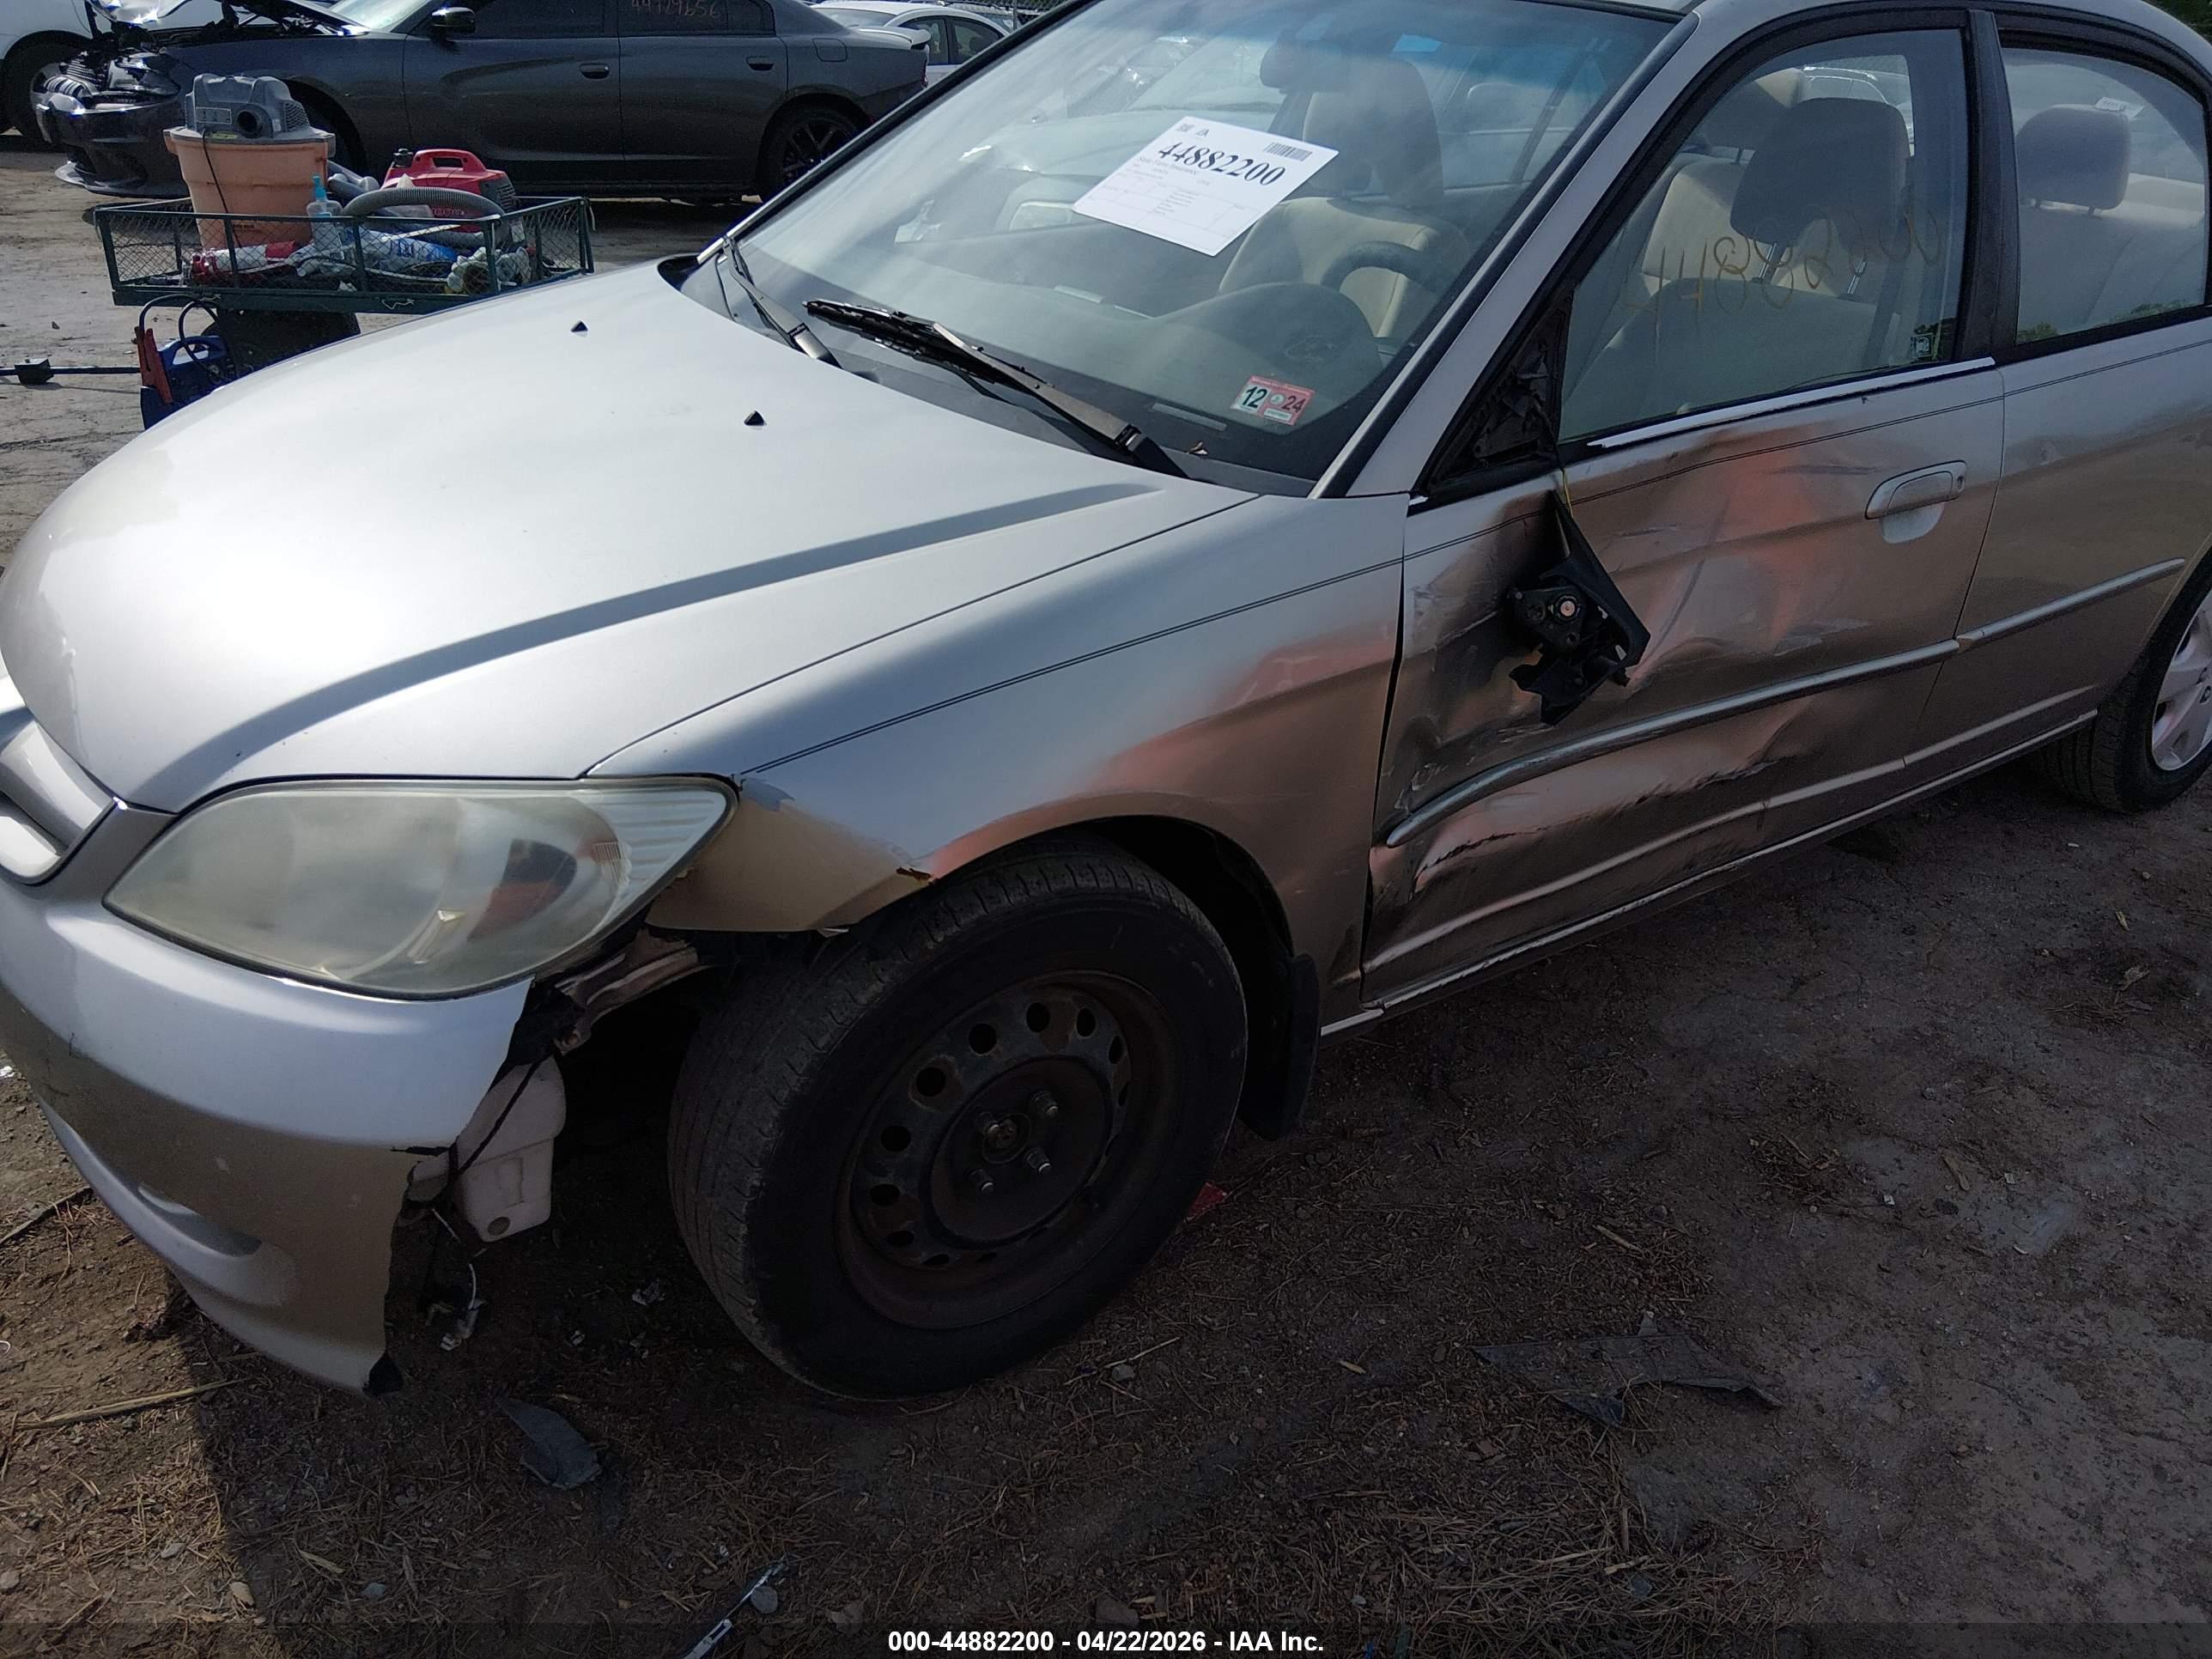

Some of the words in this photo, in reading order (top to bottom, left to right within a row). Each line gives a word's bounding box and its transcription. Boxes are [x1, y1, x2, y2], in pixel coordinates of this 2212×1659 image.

[1158, 142, 1286, 186] 44882200
[1242, 386, 1267, 409] 12
[1281, 395, 1306, 413] 24
